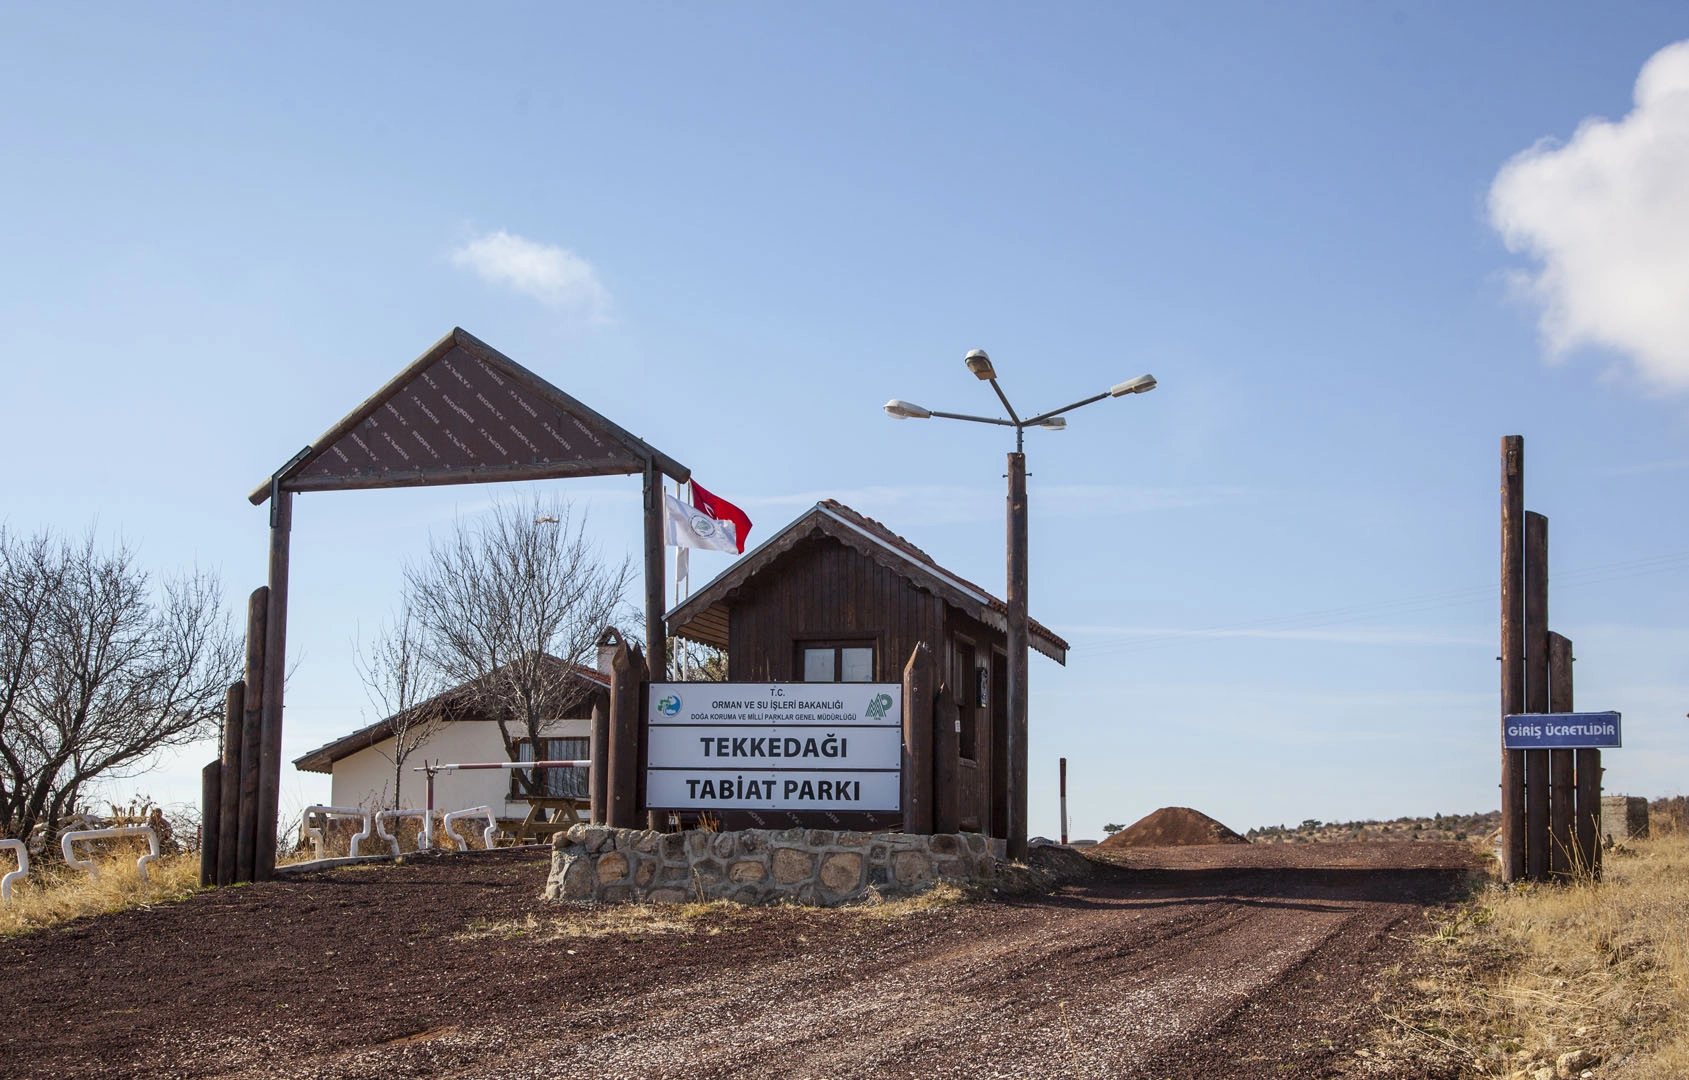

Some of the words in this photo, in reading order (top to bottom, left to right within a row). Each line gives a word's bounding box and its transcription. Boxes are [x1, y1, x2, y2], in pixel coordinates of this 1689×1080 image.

[770, 688, 785, 697] T.C.
[711, 701, 742, 709] ORMAN
[744, 701, 755, 709] VE
[757, 701, 768, 709] SU
[770, 700, 796, 711] İŞLERİ
[798, 700, 843, 710] BAKANLIĞI
[765, 713, 794, 721] PARKLAR
[795, 713, 816, 721] GENEL
[817, 713, 857, 721] MÜDÜRLÜĞÜ
[1508, 723, 1542, 739] GİRİŞ
[1545, 722, 1615, 736] ÜCRETLİDİR
[700, 733, 847, 758] TEKKEDAĞI
[686, 775, 776, 800] TABİAT
[784, 781, 860, 801] PARKI
